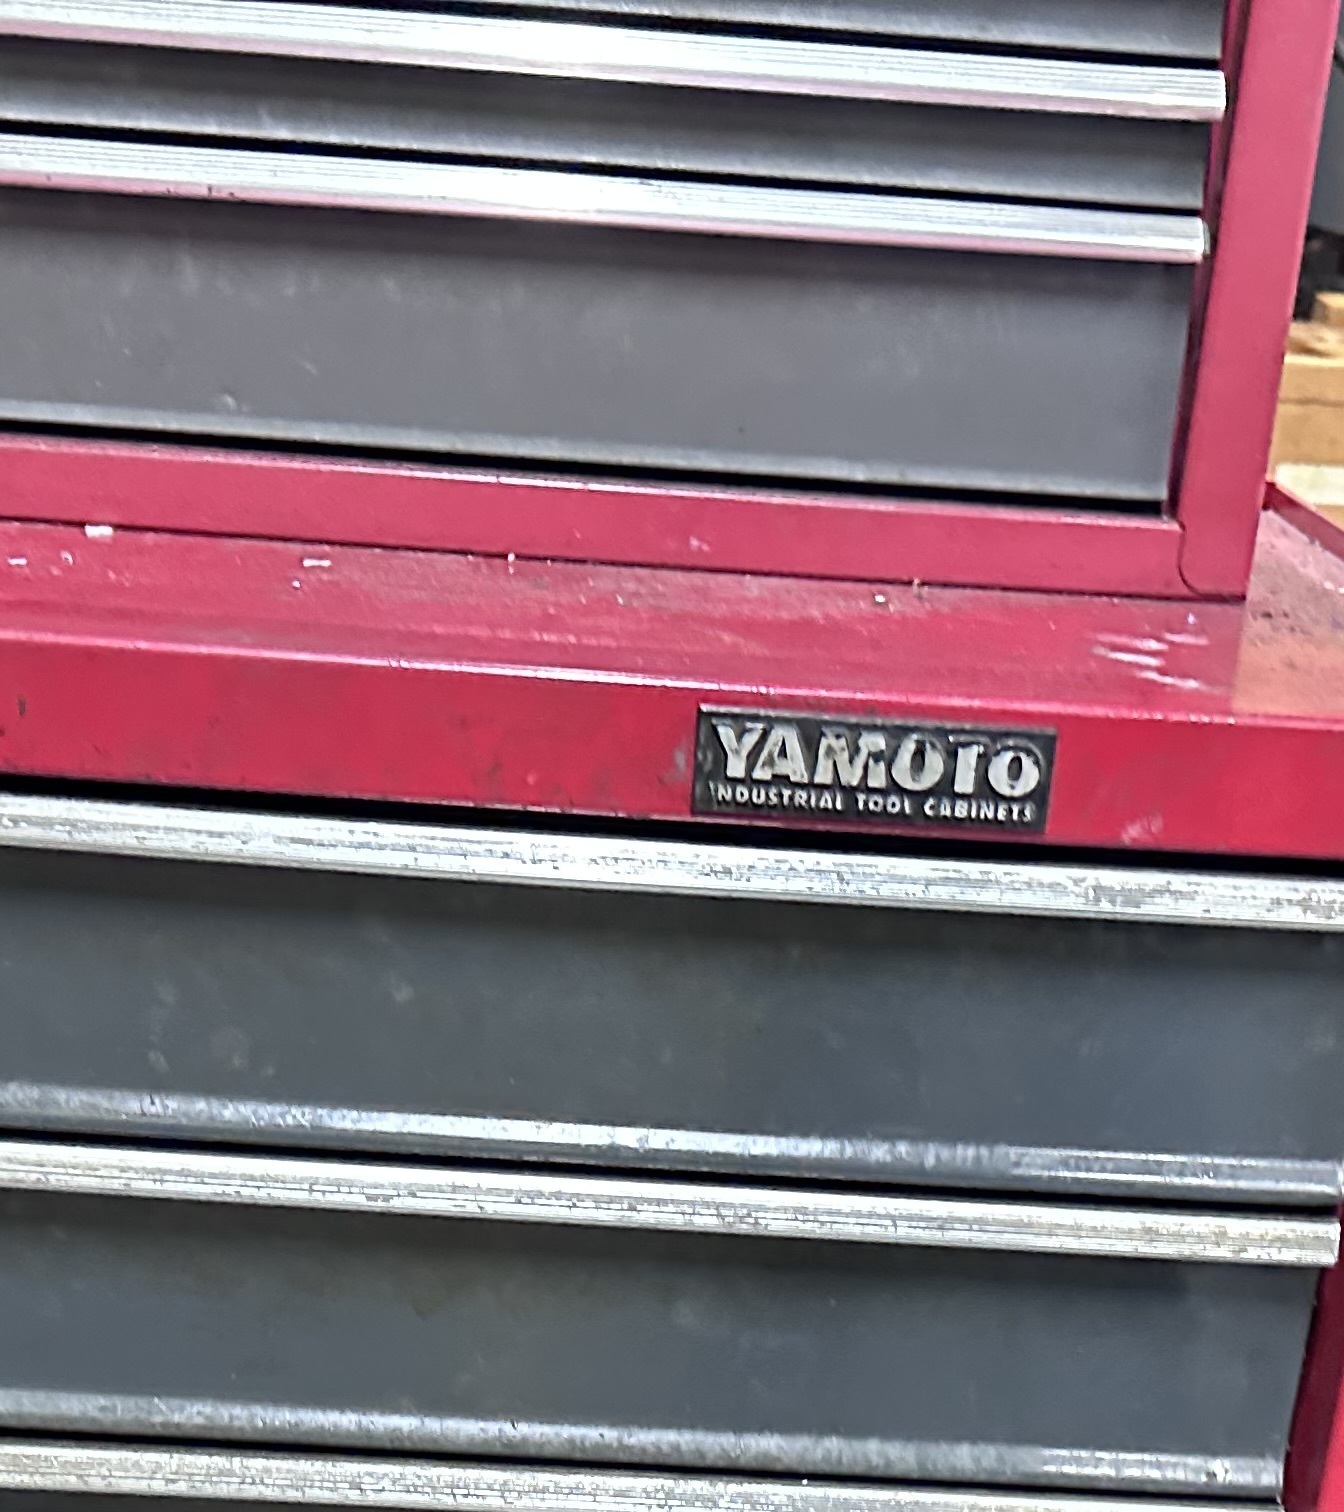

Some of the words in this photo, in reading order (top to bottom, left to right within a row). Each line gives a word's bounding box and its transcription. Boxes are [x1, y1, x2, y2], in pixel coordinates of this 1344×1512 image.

[711, 719, 1042, 798] YAMOTO
[709, 780, 843, 811] INDUSTRIAL
[857, 793, 912, 815] TOOL
[923, 797, 1036, 823] CABINETS
